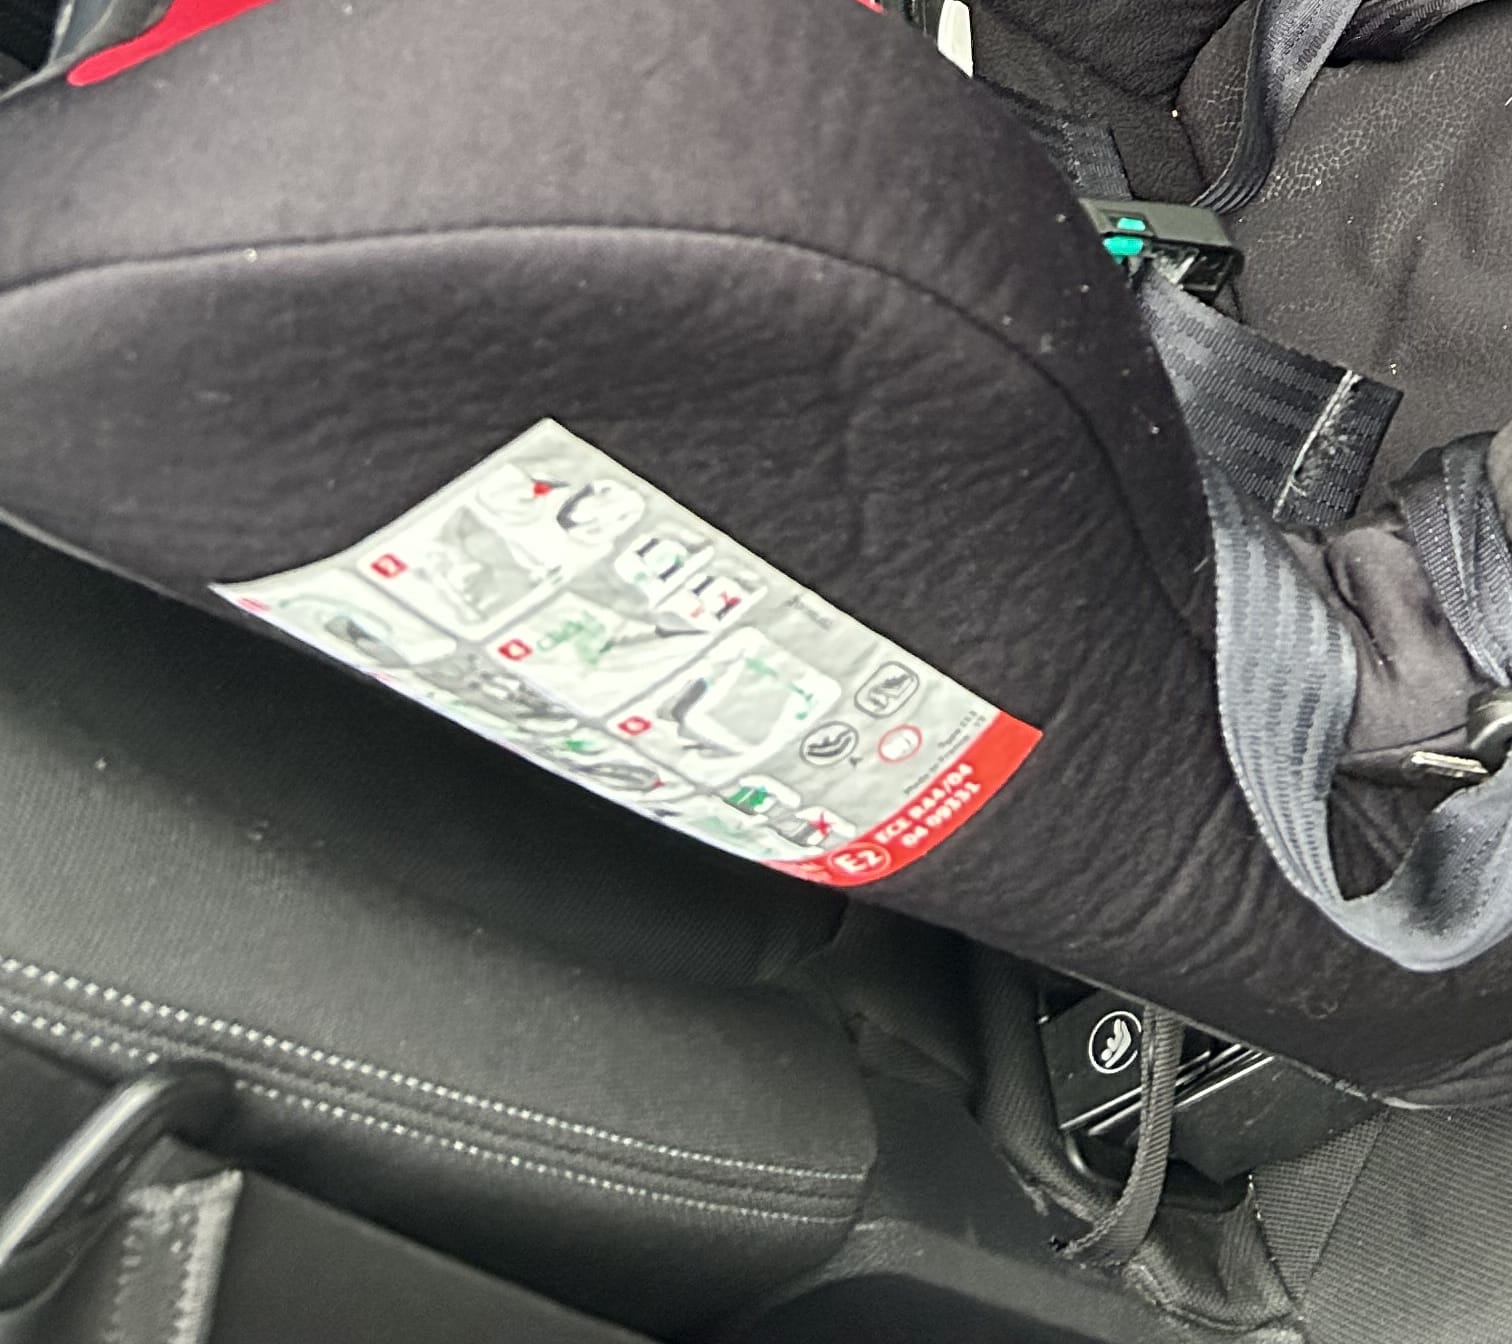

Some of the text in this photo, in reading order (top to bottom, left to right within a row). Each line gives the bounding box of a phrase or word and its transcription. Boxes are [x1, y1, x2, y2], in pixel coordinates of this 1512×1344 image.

[875, 763, 973, 843] ECE R44/04
[901, 825, 929, 849] 04
[834, 849, 884, 874] E2
